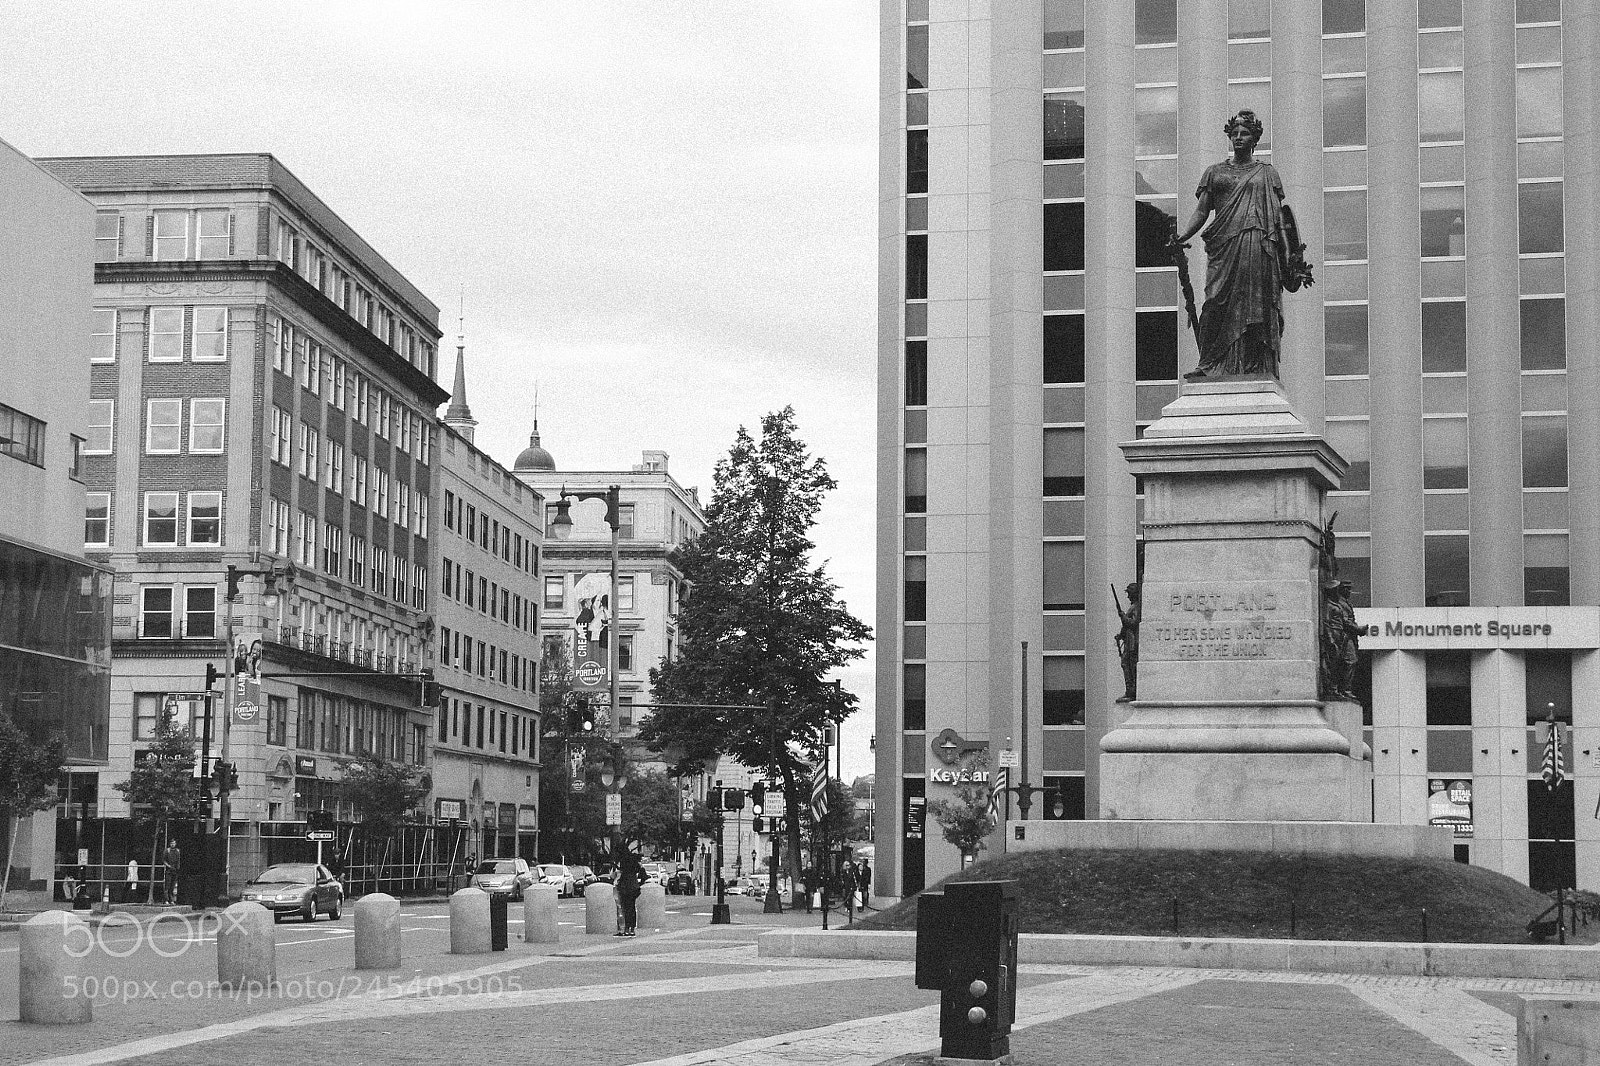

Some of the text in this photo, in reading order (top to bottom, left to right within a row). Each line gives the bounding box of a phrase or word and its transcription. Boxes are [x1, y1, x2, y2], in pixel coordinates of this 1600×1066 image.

[1171, 594, 1276, 612] PORTLAND
[1385, 621, 1482, 637] Monument
[1487, 620, 1551, 640] Square
[577, 622, 588, 657] CREATE
[575, 667, 606, 677] PORTLAND
[234, 705, 259, 714] PORTLAND
[1457, 824, 1474, 832] 1333
